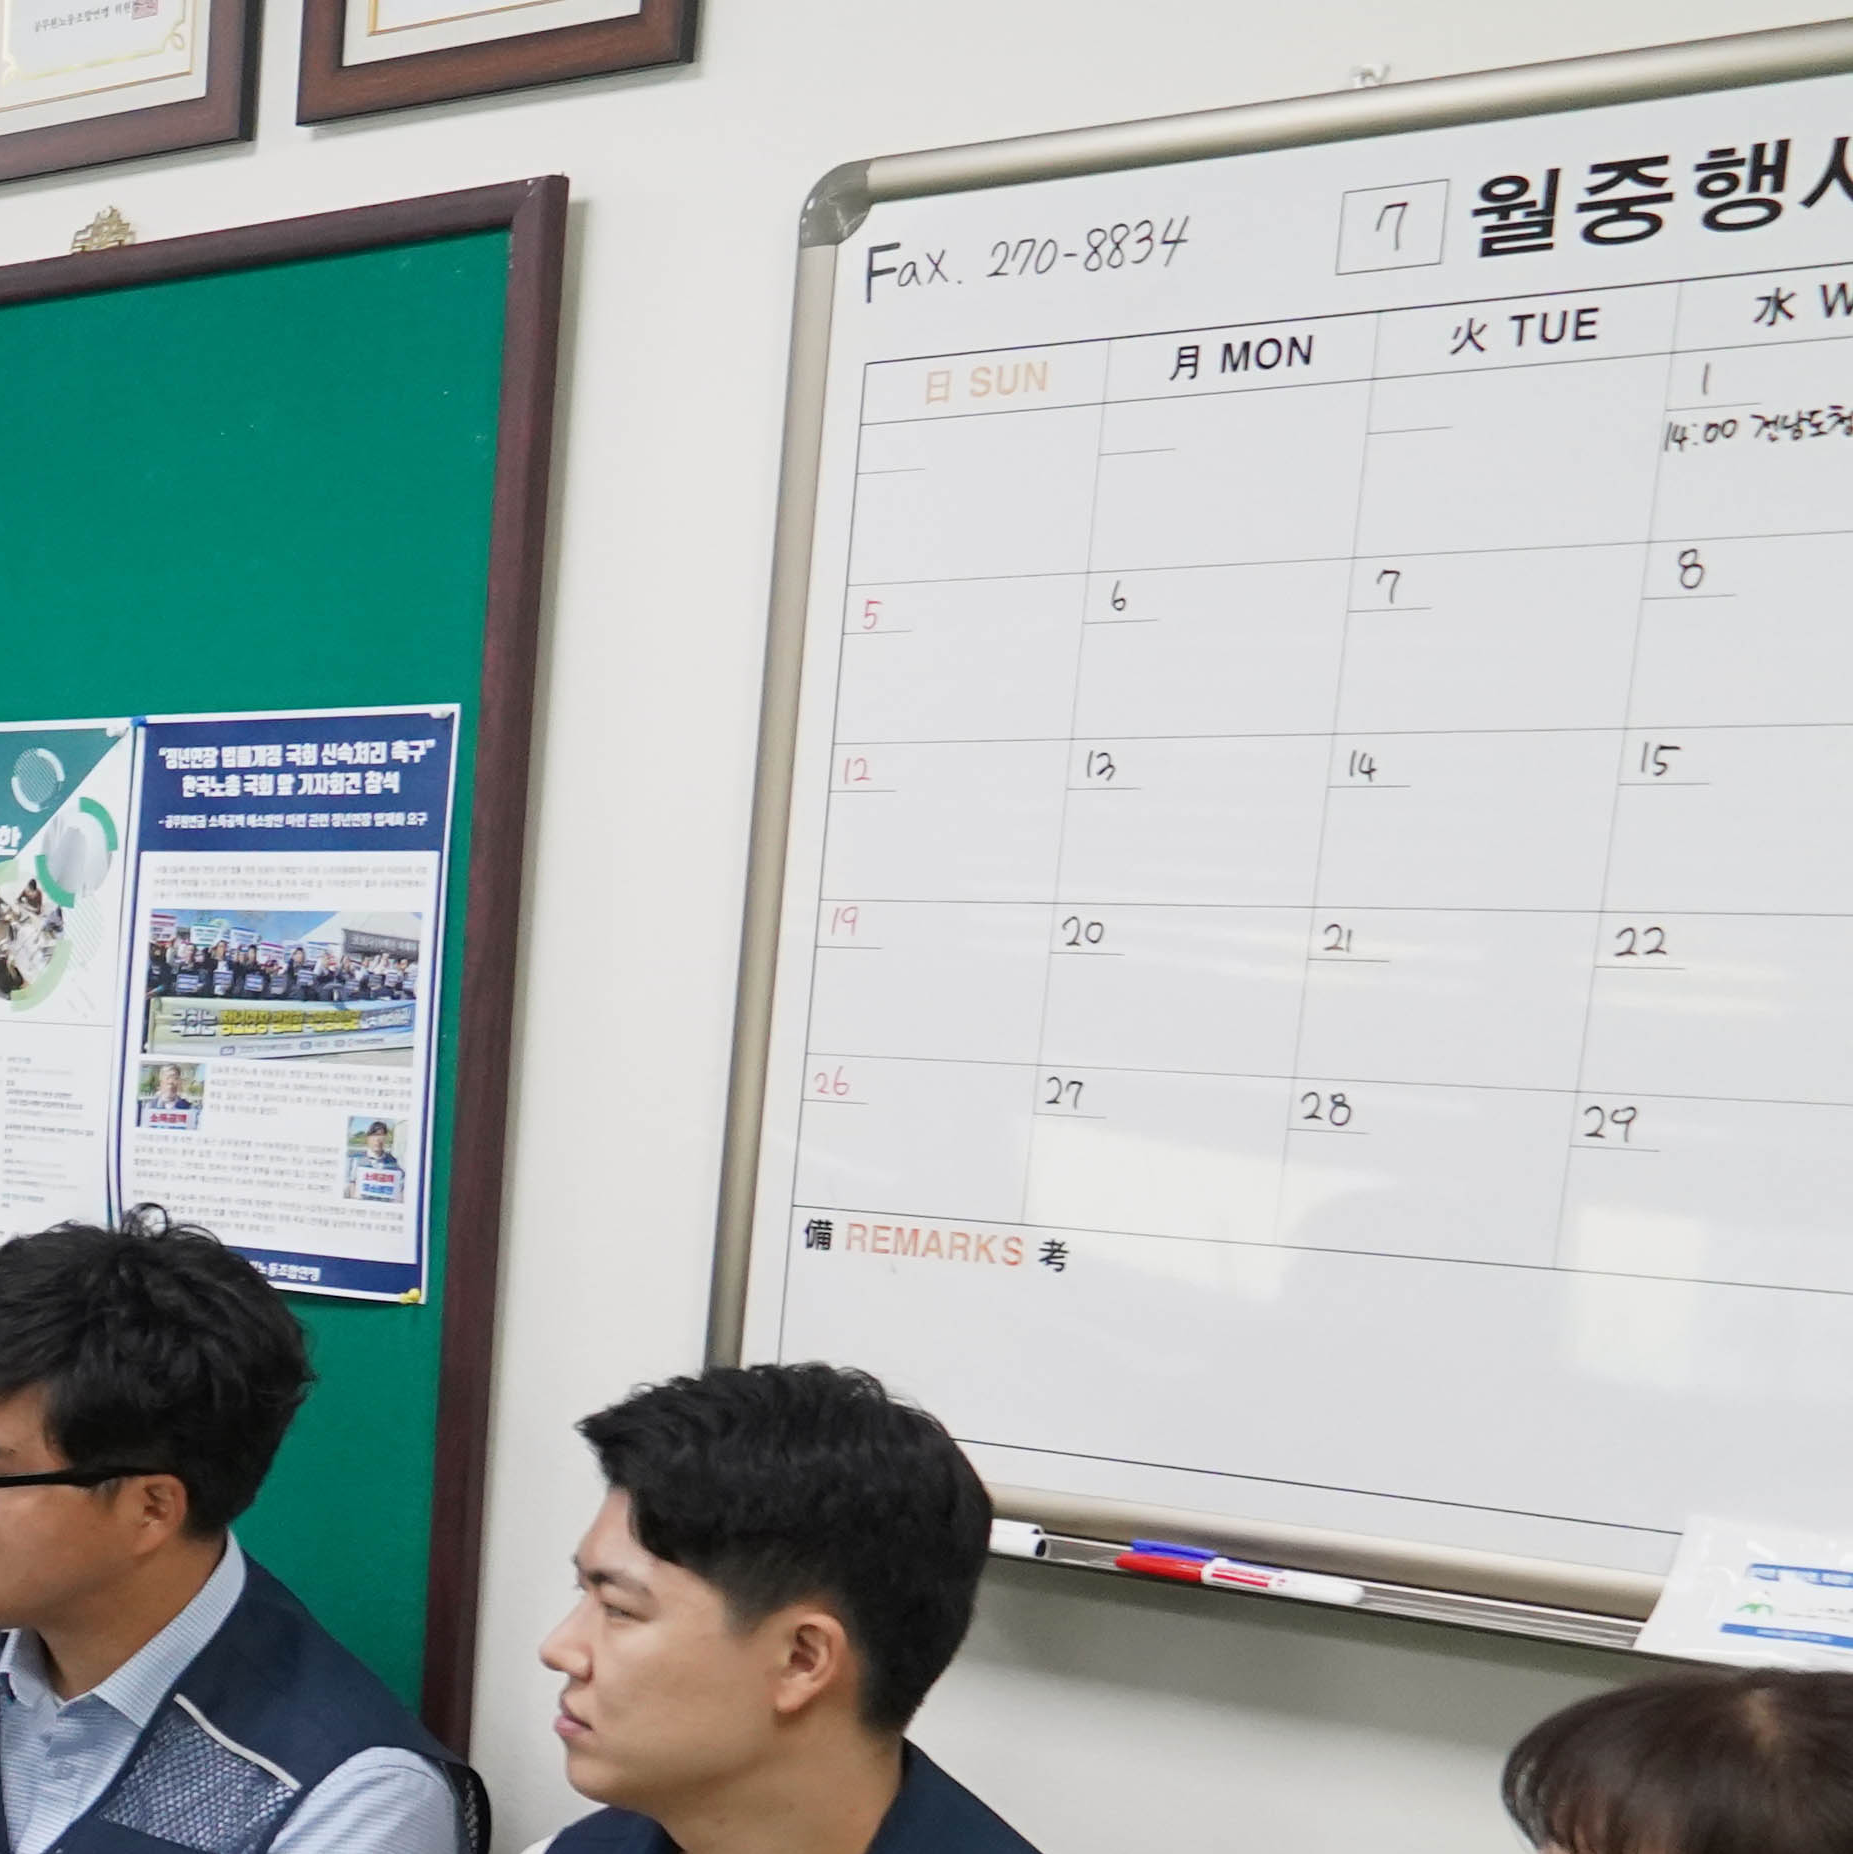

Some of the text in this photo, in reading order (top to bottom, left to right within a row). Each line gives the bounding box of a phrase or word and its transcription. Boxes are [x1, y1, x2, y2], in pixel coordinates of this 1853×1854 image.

[1374, 201, 1413, 252] 7
[987, 214, 1190, 280] 270-8834
[1753, 287, 1796, 327] 水
[1449, 317, 1488, 357] 火
[1509, 306, 1601, 350] TUE
[1169, 343, 1202, 382] 月
[1220, 334, 1315, 376] MON
[925, 370, 952, 405] 日
[968, 360, 1051, 400] SUN
[1376, 569, 1403, 606] 7
[1677, 547, 1706, 593] 8
[1111, 579, 1127, 613] 6
[860, 600, 881, 631] 5
[285, 742, 318, 766] 국회
[840, 753, 873, 785] 12
[1084, 748, 1119, 783] 13
[1346, 748, 1379, 783] 14
[1638, 741, 1682, 779] 15
[182, 774, 241, 797] 한국노총
[244, 773, 275, 797] 국회
[297, 771, 362, 796] 기자회견
[364, 770, 400, 795] 참석
[829, 904, 860, 938] 19
[1061, 915, 1106, 950] 20
[1321, 922, 1356, 955] 21
[1612, 924, 1670, 958] 22
[812, 1065, 853, 1098] 26
[1043, 1076, 1084, 1111] 27
[1299, 1091, 1355, 1128] 28
[1581, 1104, 1637, 1143] 29
[844, 1222, 1026, 1267] REMARKS
[1037, 1238, 1071, 1273] 考
